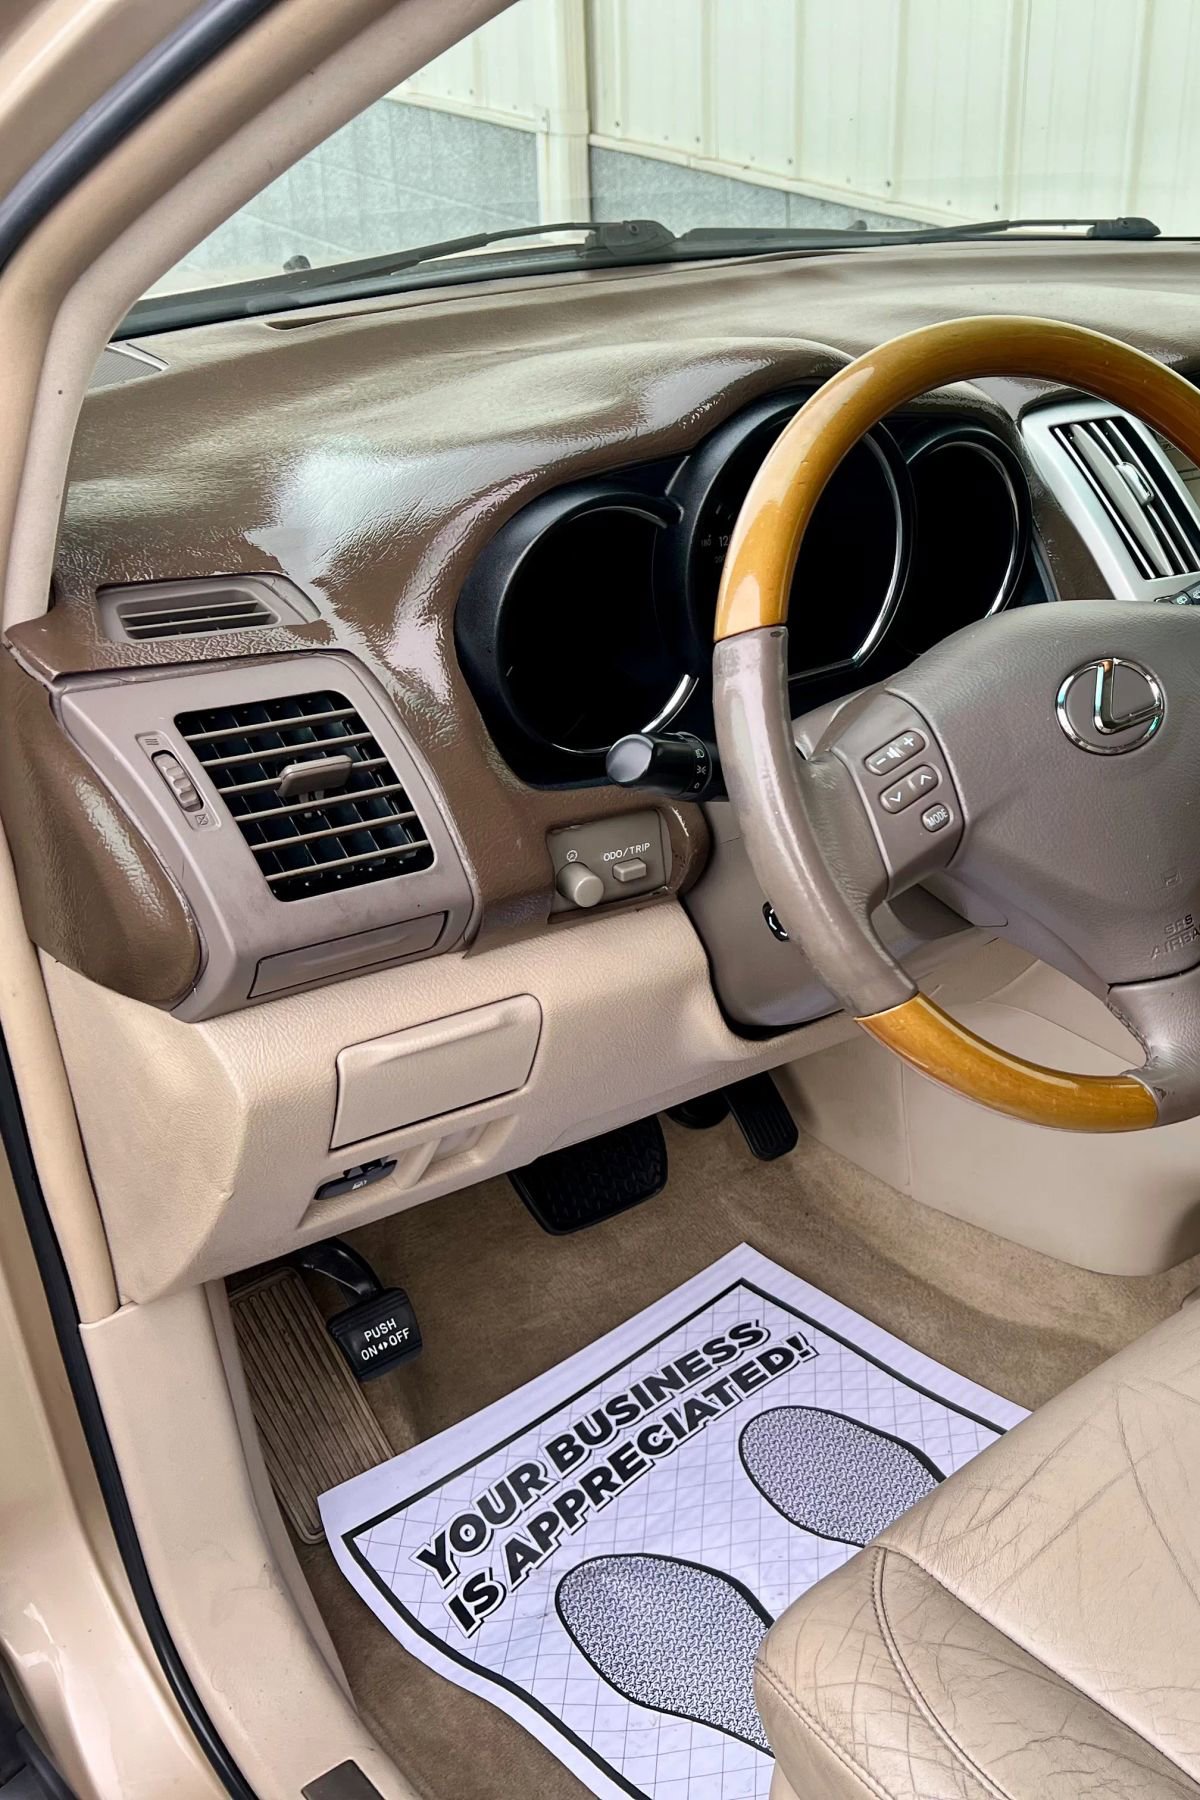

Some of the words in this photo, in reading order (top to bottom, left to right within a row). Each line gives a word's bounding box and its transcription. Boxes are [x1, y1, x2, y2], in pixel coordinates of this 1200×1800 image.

[927, 808, 949, 827] MODE
[603, 842, 651, 862] ODO/TRIP
[1163, 913, 1194, 935] SRS
[363, 1317, 397, 1342] PUSH
[416, 1461, 549, 1585] YOUR
[548, 1320, 771, 1475] BUSINESS
[446, 1570, 505, 1635] IS
[504, 1333, 820, 1588] APPRECIATED!
